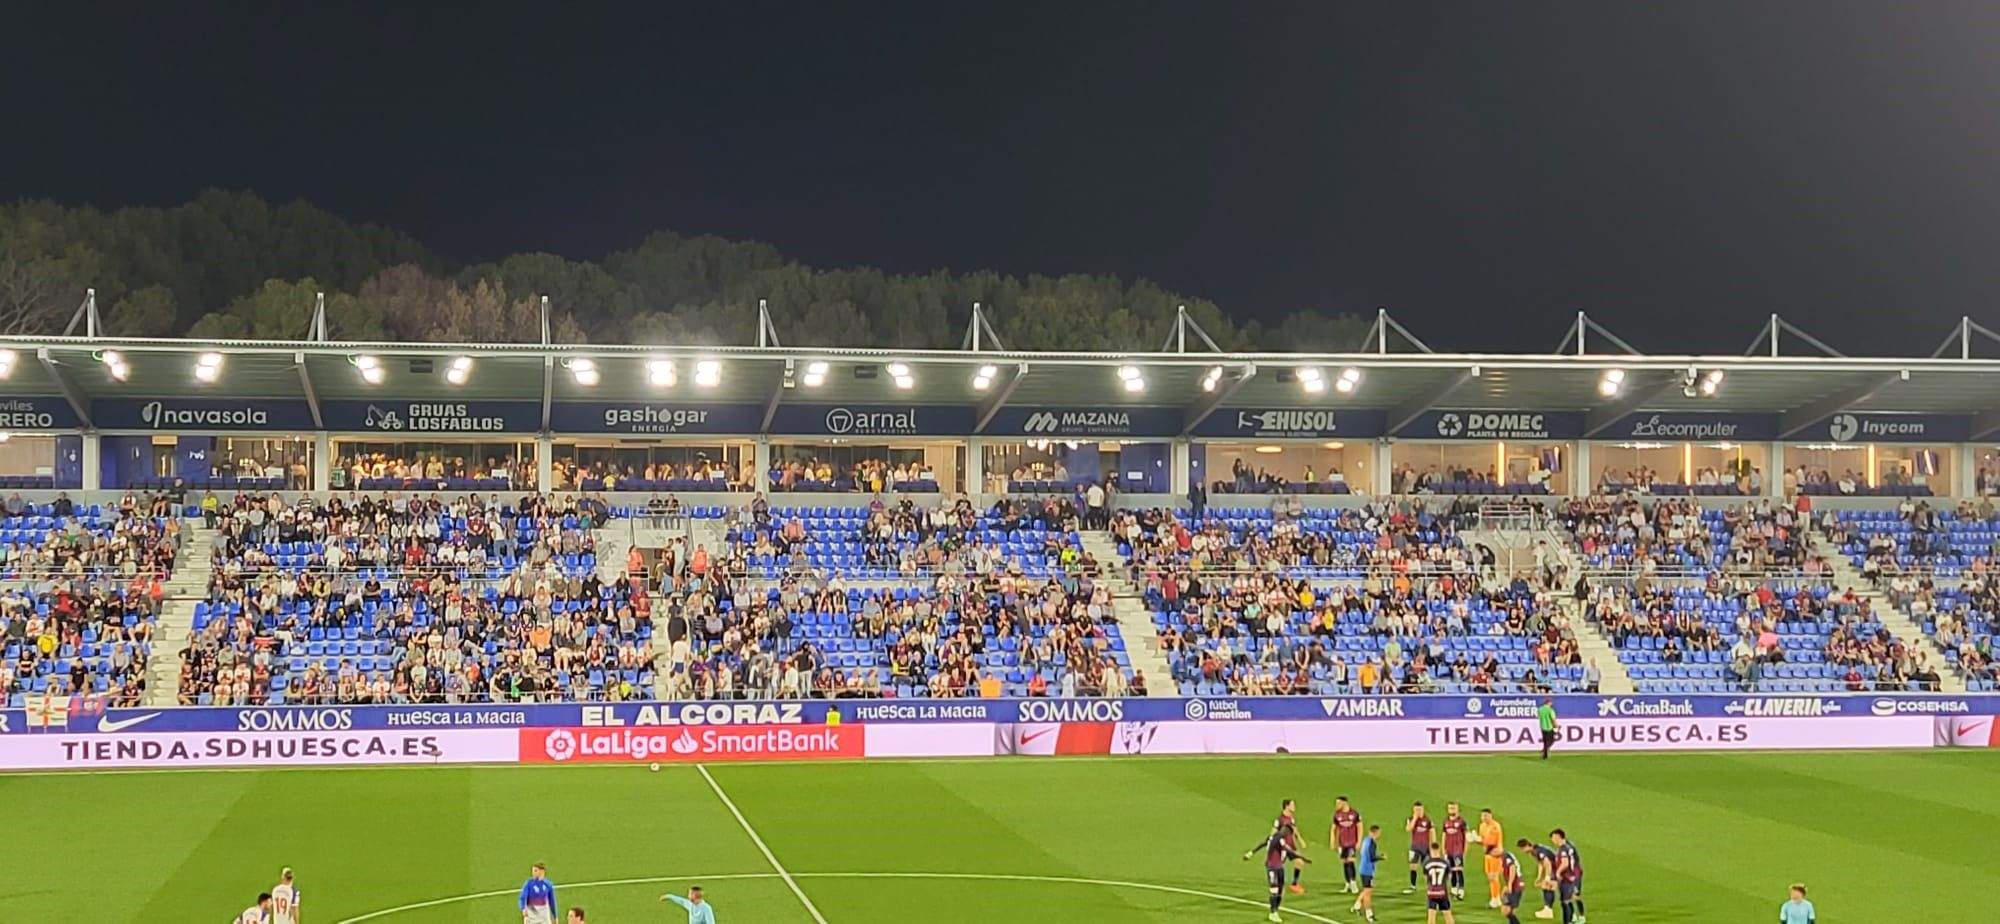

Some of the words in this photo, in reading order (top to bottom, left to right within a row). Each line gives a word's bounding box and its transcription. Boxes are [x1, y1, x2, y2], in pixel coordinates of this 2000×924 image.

[0, 400, 33, 410] viles
[409, 404, 467, 417] GRUAS
[0, 413, 52, 427] RERO
[164, 408, 267, 424] navasola
[409, 417, 503, 430] LOSFABLOS
[855, 408, 916, 428] arnal
[1061, 412, 1130, 425] MAZANA
[1467, 414, 1543, 430] DOMEC
[1466, 430, 1496, 438] PLANTA
[1657, 422, 1737, 439] ecomputer
[1863, 420, 1924, 435] Inycom
[581, 705, 625, 727] EL
[635, 703, 803, 727] ALCORAZ
[1018, 701, 1123, 722] SOMMOS
[1208, 708, 1252, 719] emotion
[1336, 699, 1404, 717] AMBAR
[1495, 706, 1539, 718] CABRER
[1619, 698, 1694, 716] CaixaBank
[1744, 698, 1823, 716] CLAVERIA
[1898, 701, 1969, 713] COSEHISA
[238, 708, 352, 731] SOMMOS
[61, 736, 438, 761] TIENDA.SDHUESCA.ES
[580, 730, 667, 759] LaLiga
[702, 728, 840, 753] SmartBank
[1428, 868, 1446, 886] 17
[275, 897, 288, 915] 19
